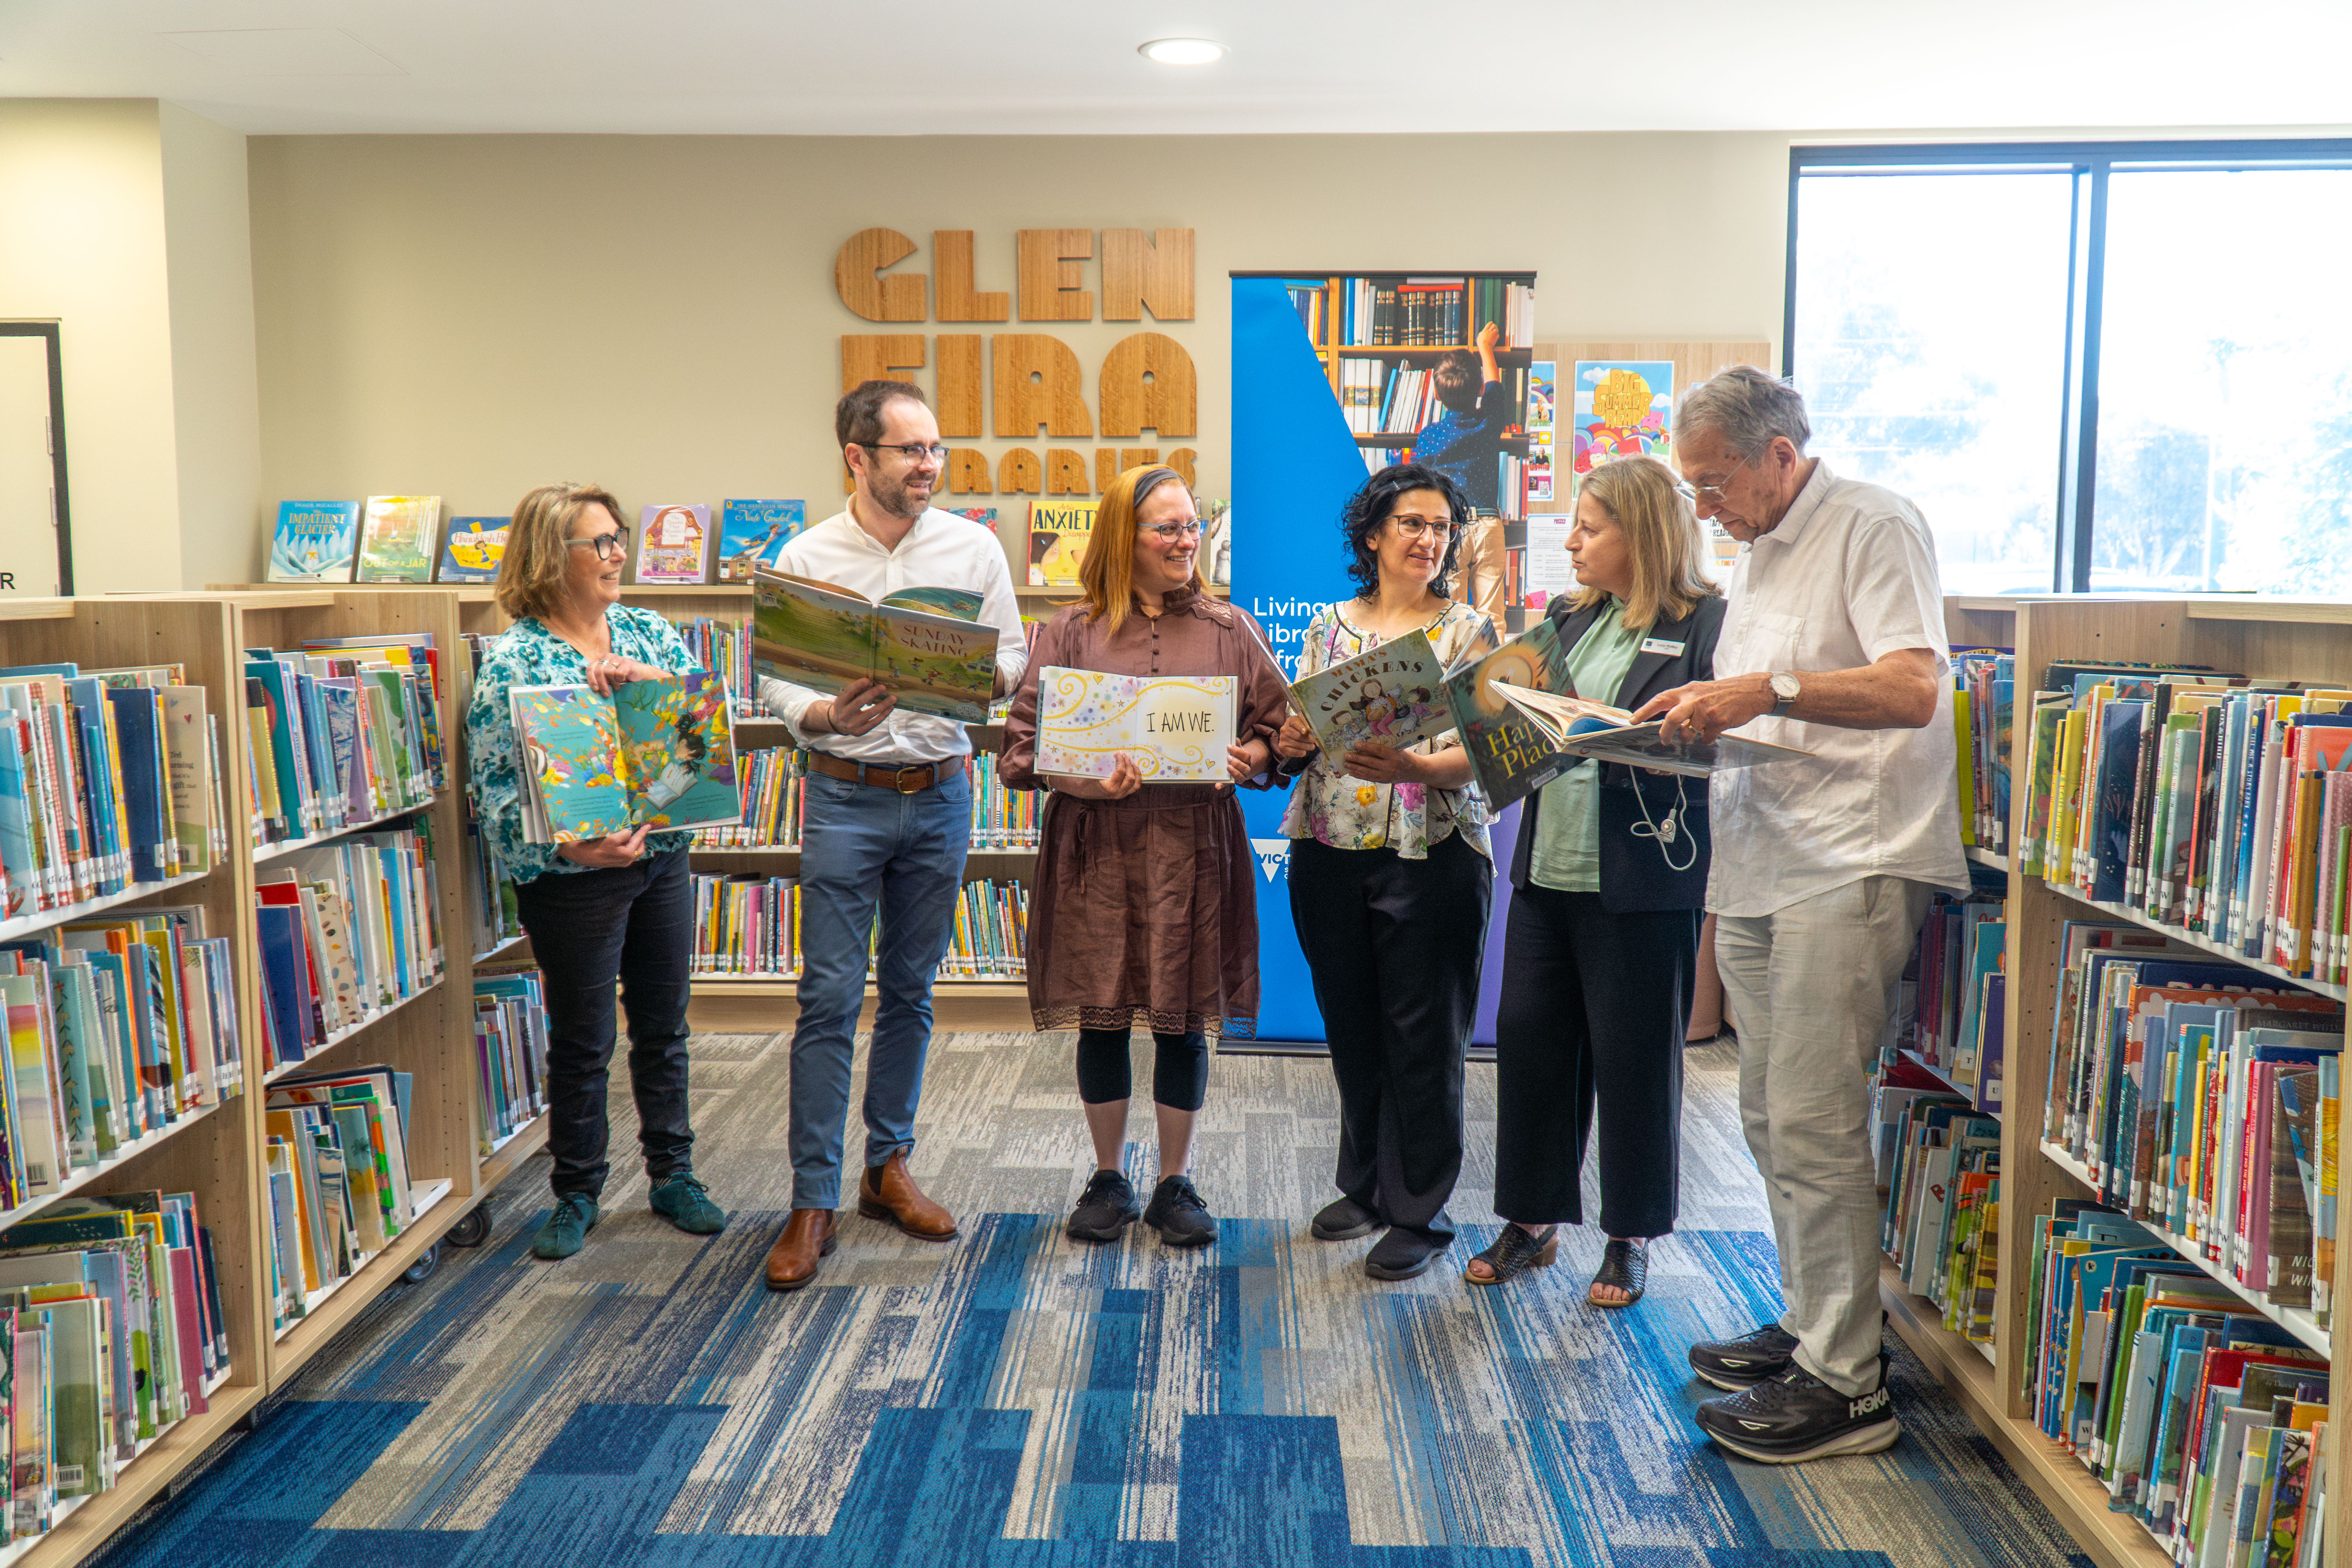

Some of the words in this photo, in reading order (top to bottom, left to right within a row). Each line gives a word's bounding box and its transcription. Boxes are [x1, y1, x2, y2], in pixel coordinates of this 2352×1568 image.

[835, 227, 1194, 321] GLEN
[1610, 368, 1640, 394] BIG
[1592, 385, 1653, 416] SUMMER
[1605, 409, 1642, 429] READ
[289, 513, 345, 523] IMPATIENT
[1034, 509, 1099, 530] ANXIET
[295, 524, 336, 534] GLACIER
[454, 532, 494, 543] Hanukkah
[496, 532, 507, 543] H
[1063, 530, 1091, 541] Disappe
[364, 558, 388, 568] OUT
[405, 558, 426, 568] JAR
[904, 625, 969, 645] SUNDAY
[900, 637, 968, 657] SKATING
[1330, 649, 1387, 679] MAMA'S
[1320, 660, 1425, 711] CHICKENS
[1146, 712, 1155, 732] I
[1162, 711, 1185, 732] AM
[1188, 711, 1214, 732] WE.
[1486, 719, 1538, 757] Hap
[2175, 737, 2181, 748] WE
[1500, 738, 1555, 779] Plac
[2248, 749, 2254, 760] ME
[1259, 854, 1290, 864] VICT
[2258, 1019, 2308, 1029] MARGARET
[2292, 1256, 2312, 1267] NIC
[1849, 1387, 1889, 1418] HOKA
